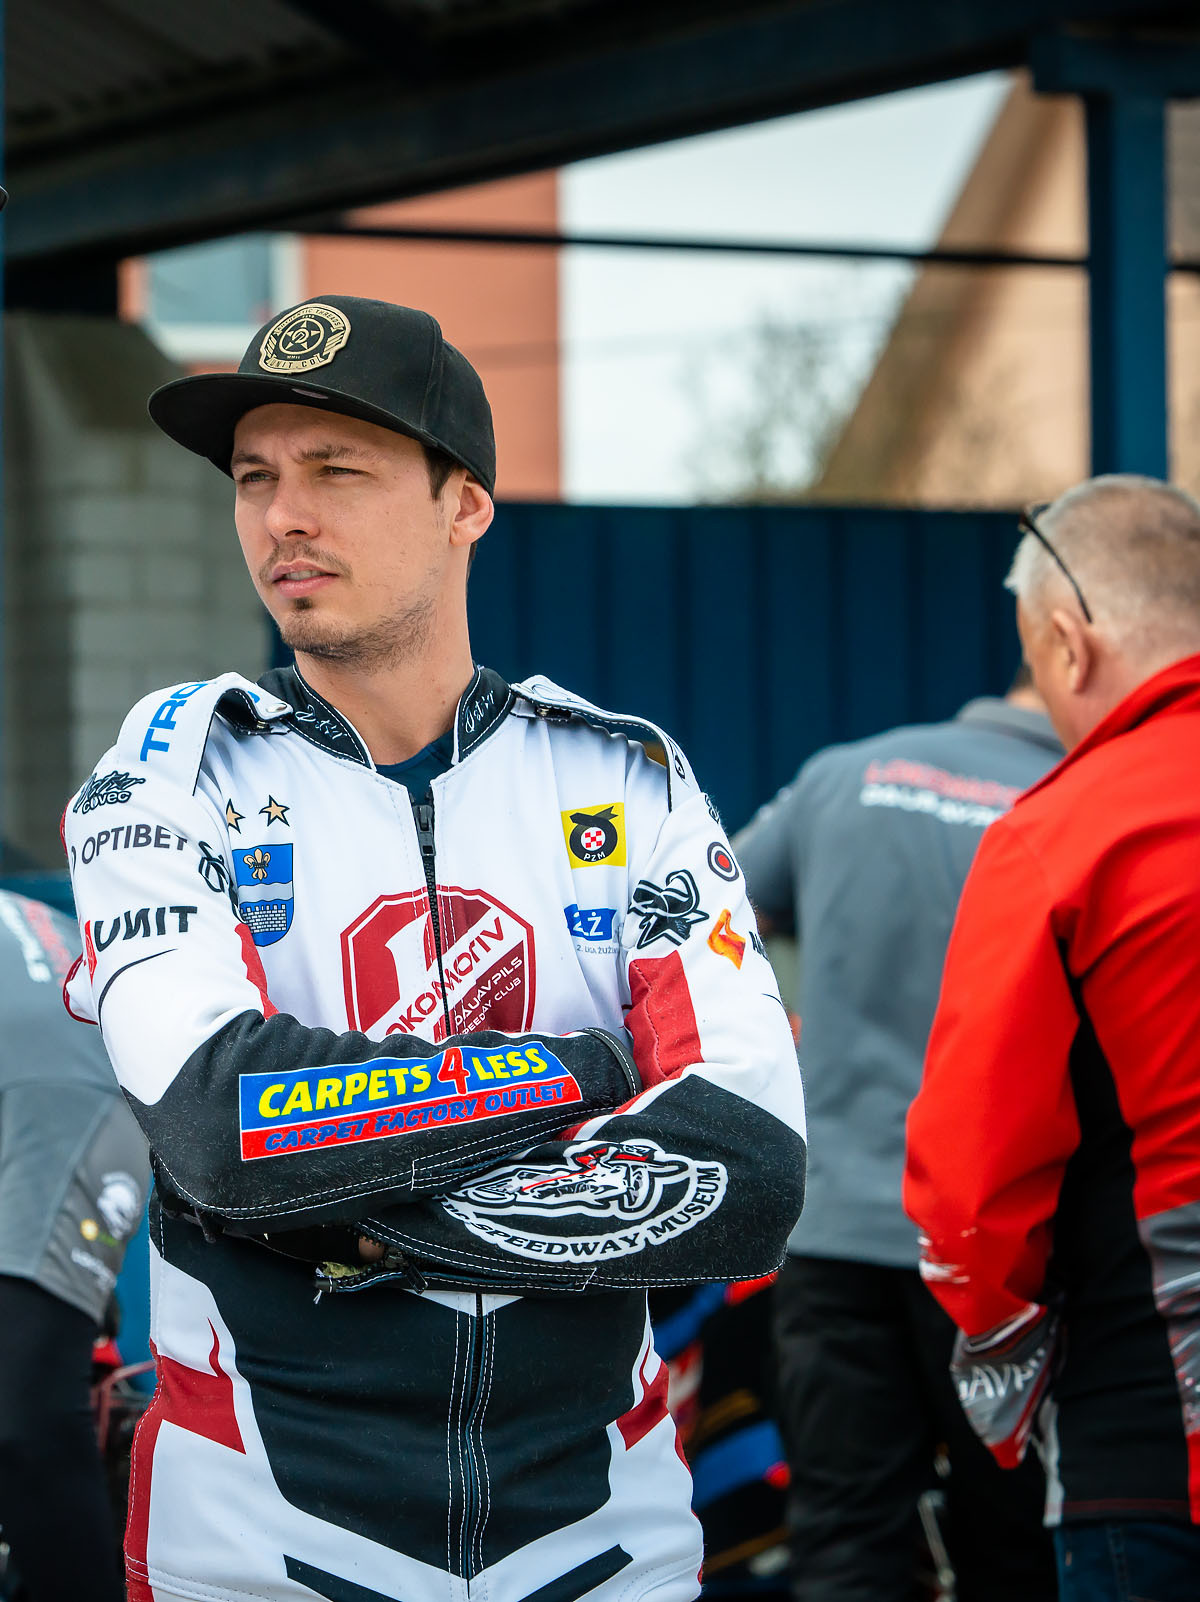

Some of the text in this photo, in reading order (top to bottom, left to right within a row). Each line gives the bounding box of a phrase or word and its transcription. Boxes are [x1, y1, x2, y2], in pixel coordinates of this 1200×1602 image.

[139, 683, 209, 762] TRO
[81, 823, 188, 865] OPTIBET
[583, 851, 606, 863] PZM
[385, 916, 504, 1036] OKOMOTIV
[494, 977, 522, 1002] CLUB
[257, 1047, 549, 1118] CARPETS 4 LESS
[265, 1082, 566, 1151] CARPET FACTORY OUTLET
[469, 1166, 720, 1257] SPEEDWAY MUSEUM
